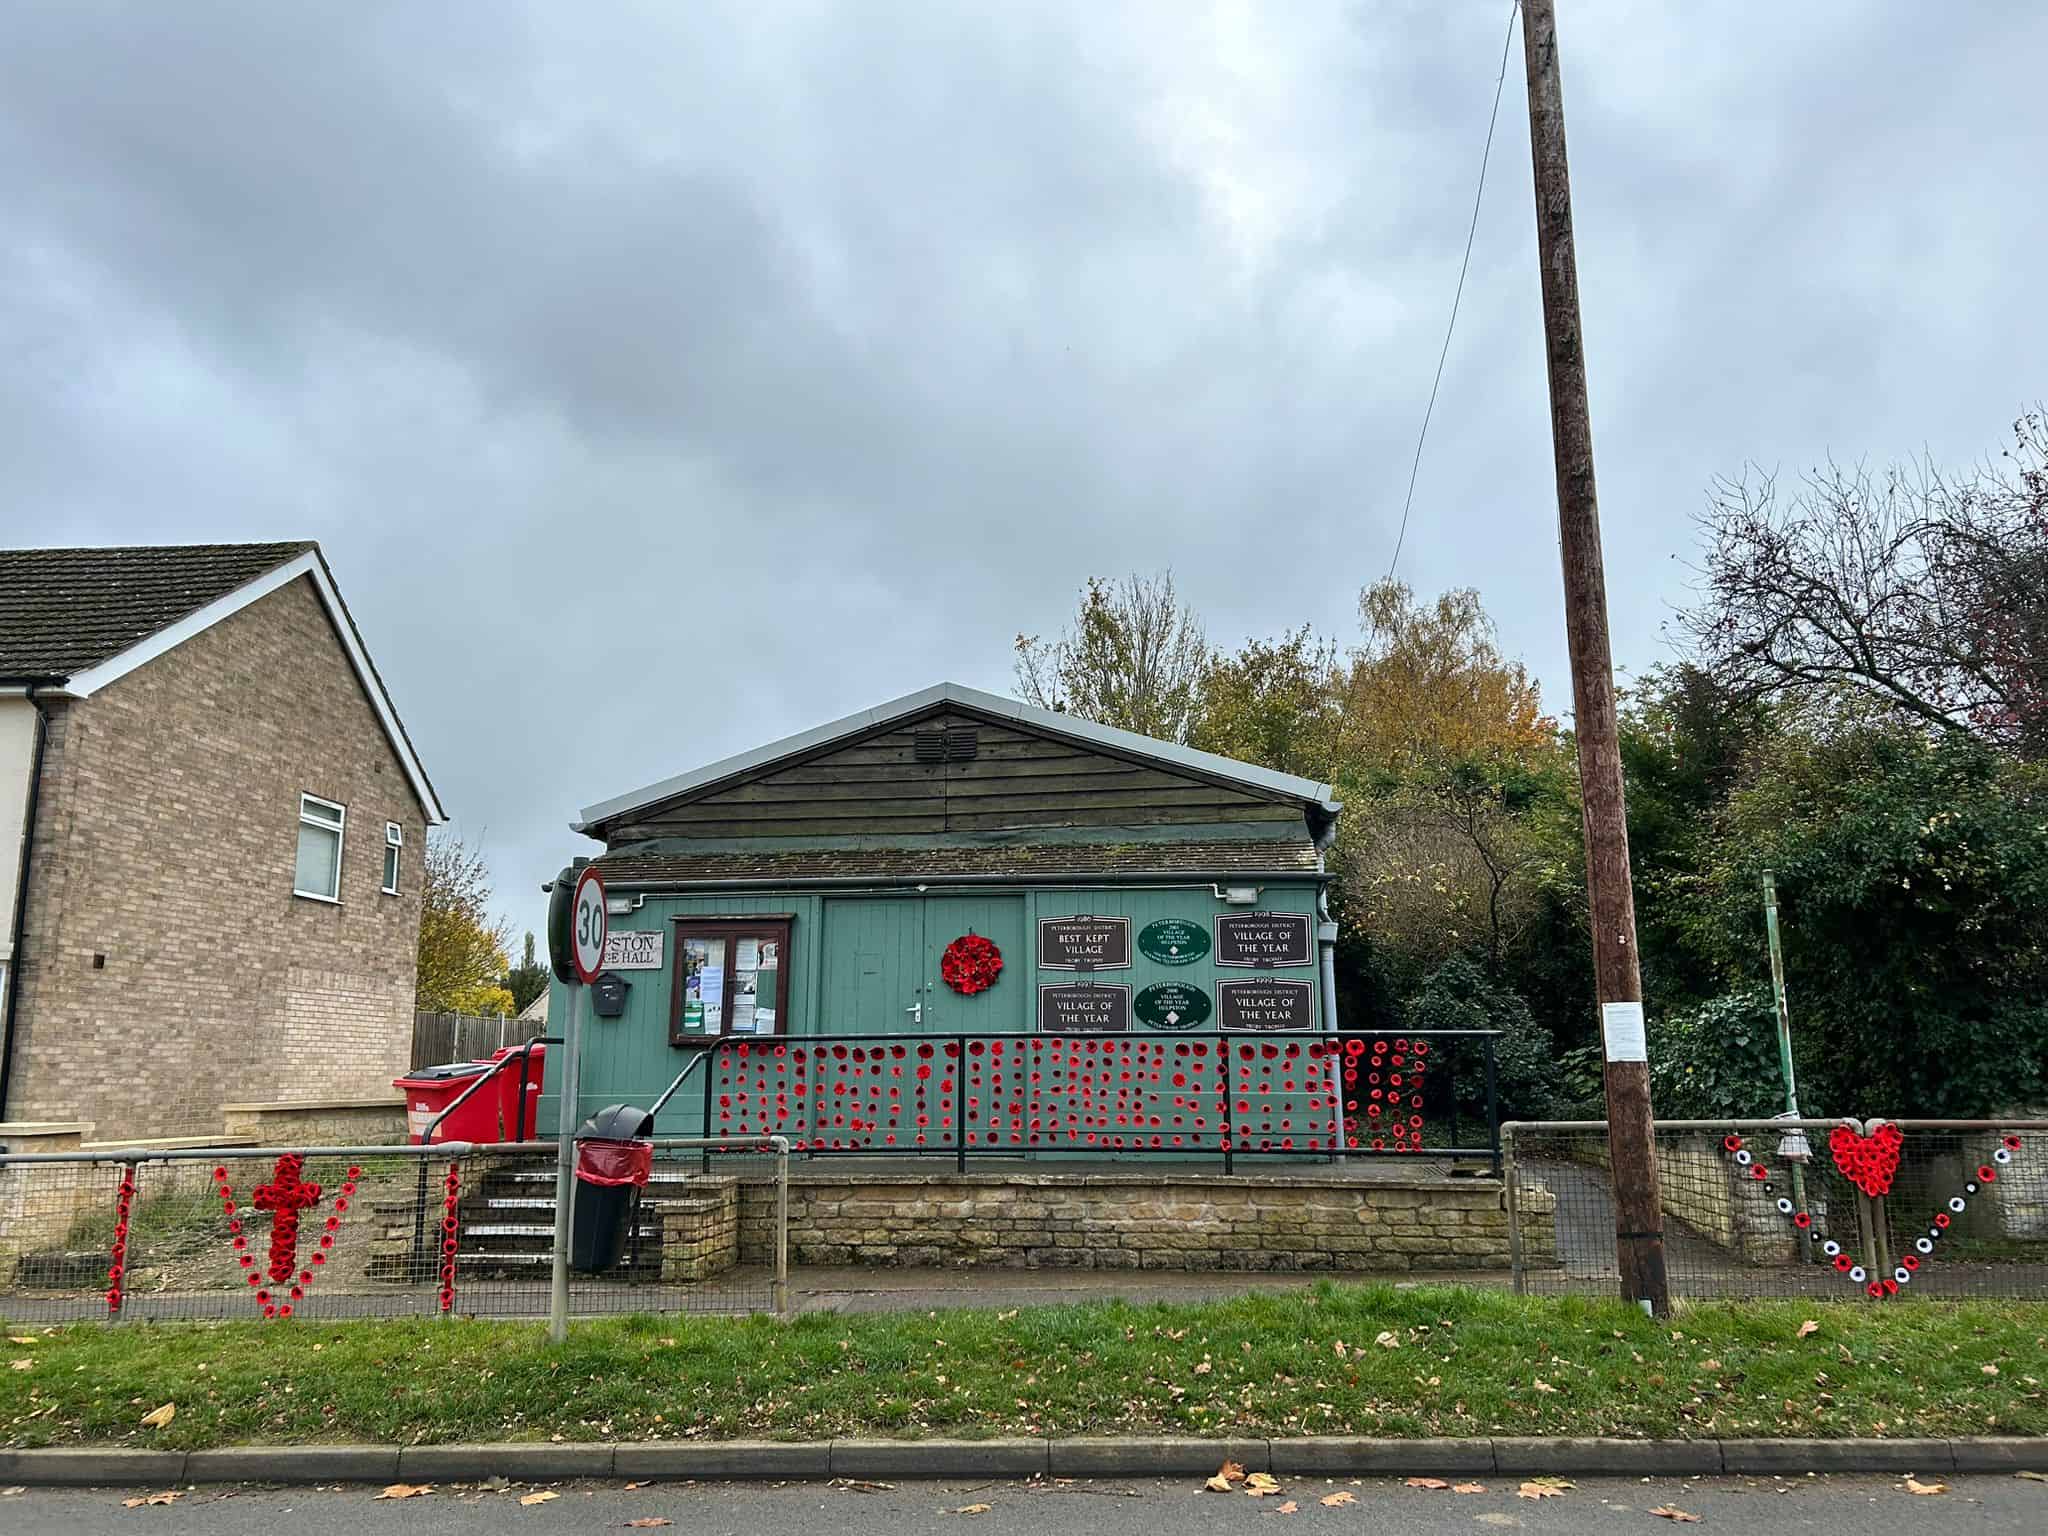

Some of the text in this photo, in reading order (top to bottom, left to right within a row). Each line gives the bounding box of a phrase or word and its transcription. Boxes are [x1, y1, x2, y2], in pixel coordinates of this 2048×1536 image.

[578, 900, 602, 950] 30
[1058, 934, 1110, 943] BEST KEPT
[1233, 931, 1292, 940] VILLAGE OF
[1065, 945, 1104, 954] VILLAGE
[1237, 943, 1290, 953] THE YEAR
[622, 951, 654, 963] HALL
[1056, 1001, 1113, 1010] VILLAGE OF
[1235, 998, 1295, 1007] VILLAGE OF
[1060, 1014, 1110, 1023] THE YEAR
[1239, 1010, 1292, 1019] THE YEAR
